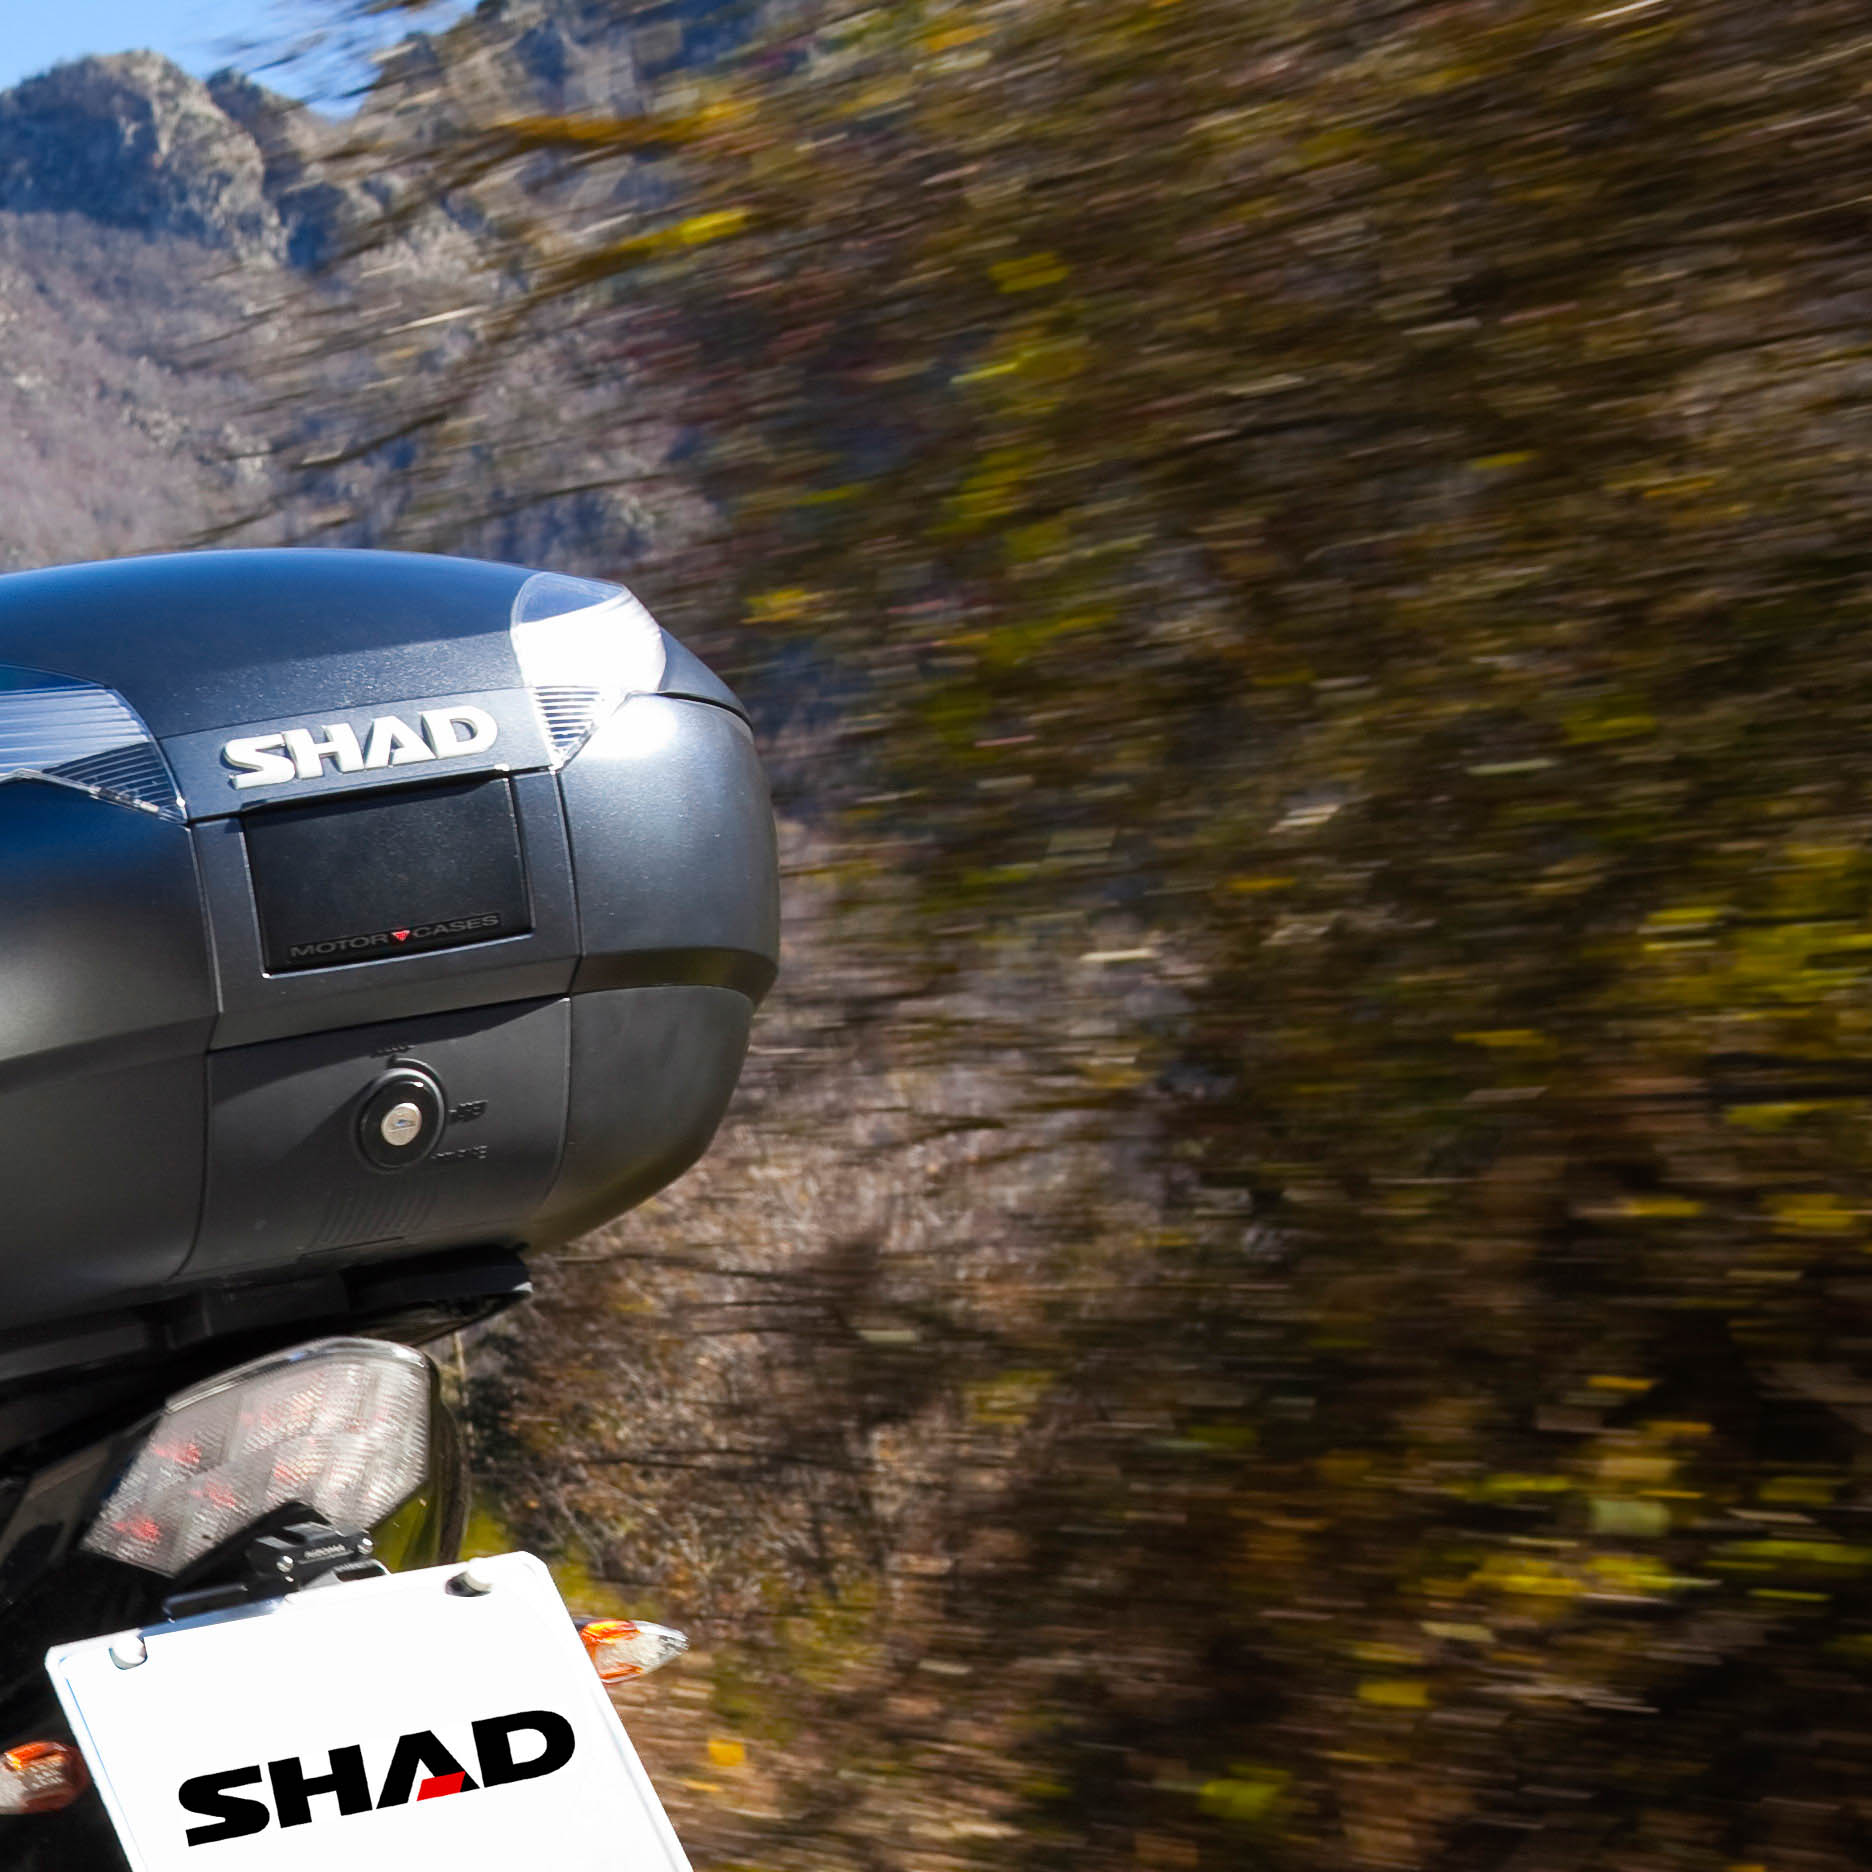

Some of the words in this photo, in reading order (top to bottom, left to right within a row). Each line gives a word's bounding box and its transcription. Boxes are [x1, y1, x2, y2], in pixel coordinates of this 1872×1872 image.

[223, 705, 499, 790] SHAD
[290, 933, 389, 957] MOTOR
[412, 915, 499, 938] CASES
[178, 1710, 576, 1847] SHAD
